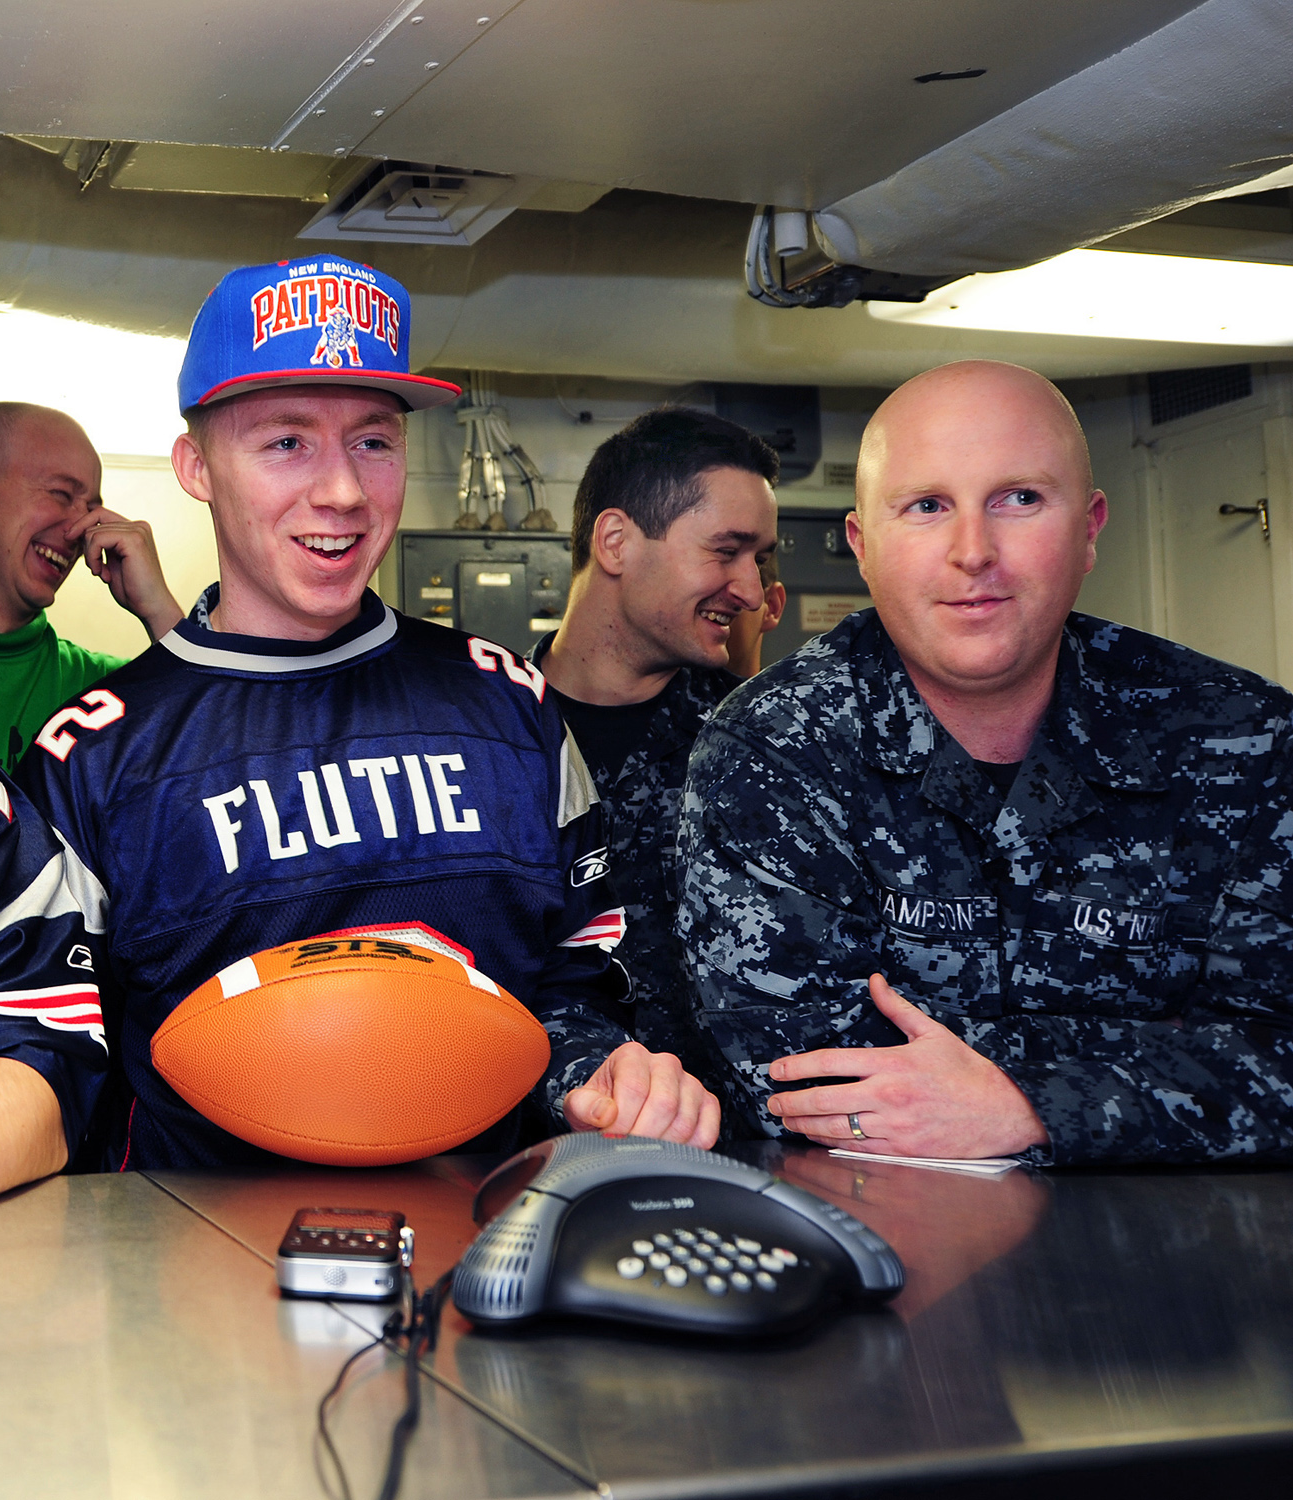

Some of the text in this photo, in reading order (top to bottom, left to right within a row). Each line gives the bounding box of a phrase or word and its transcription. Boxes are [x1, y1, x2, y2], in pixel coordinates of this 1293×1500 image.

[289, 262, 376, 284] NEW ENGLAND
[251, 275, 401, 356] PATRIOTS
[35, 689, 125, 762] 2
[202, 753, 482, 875] FLUTIE
[1074, 904, 1115, 938] U.S.
